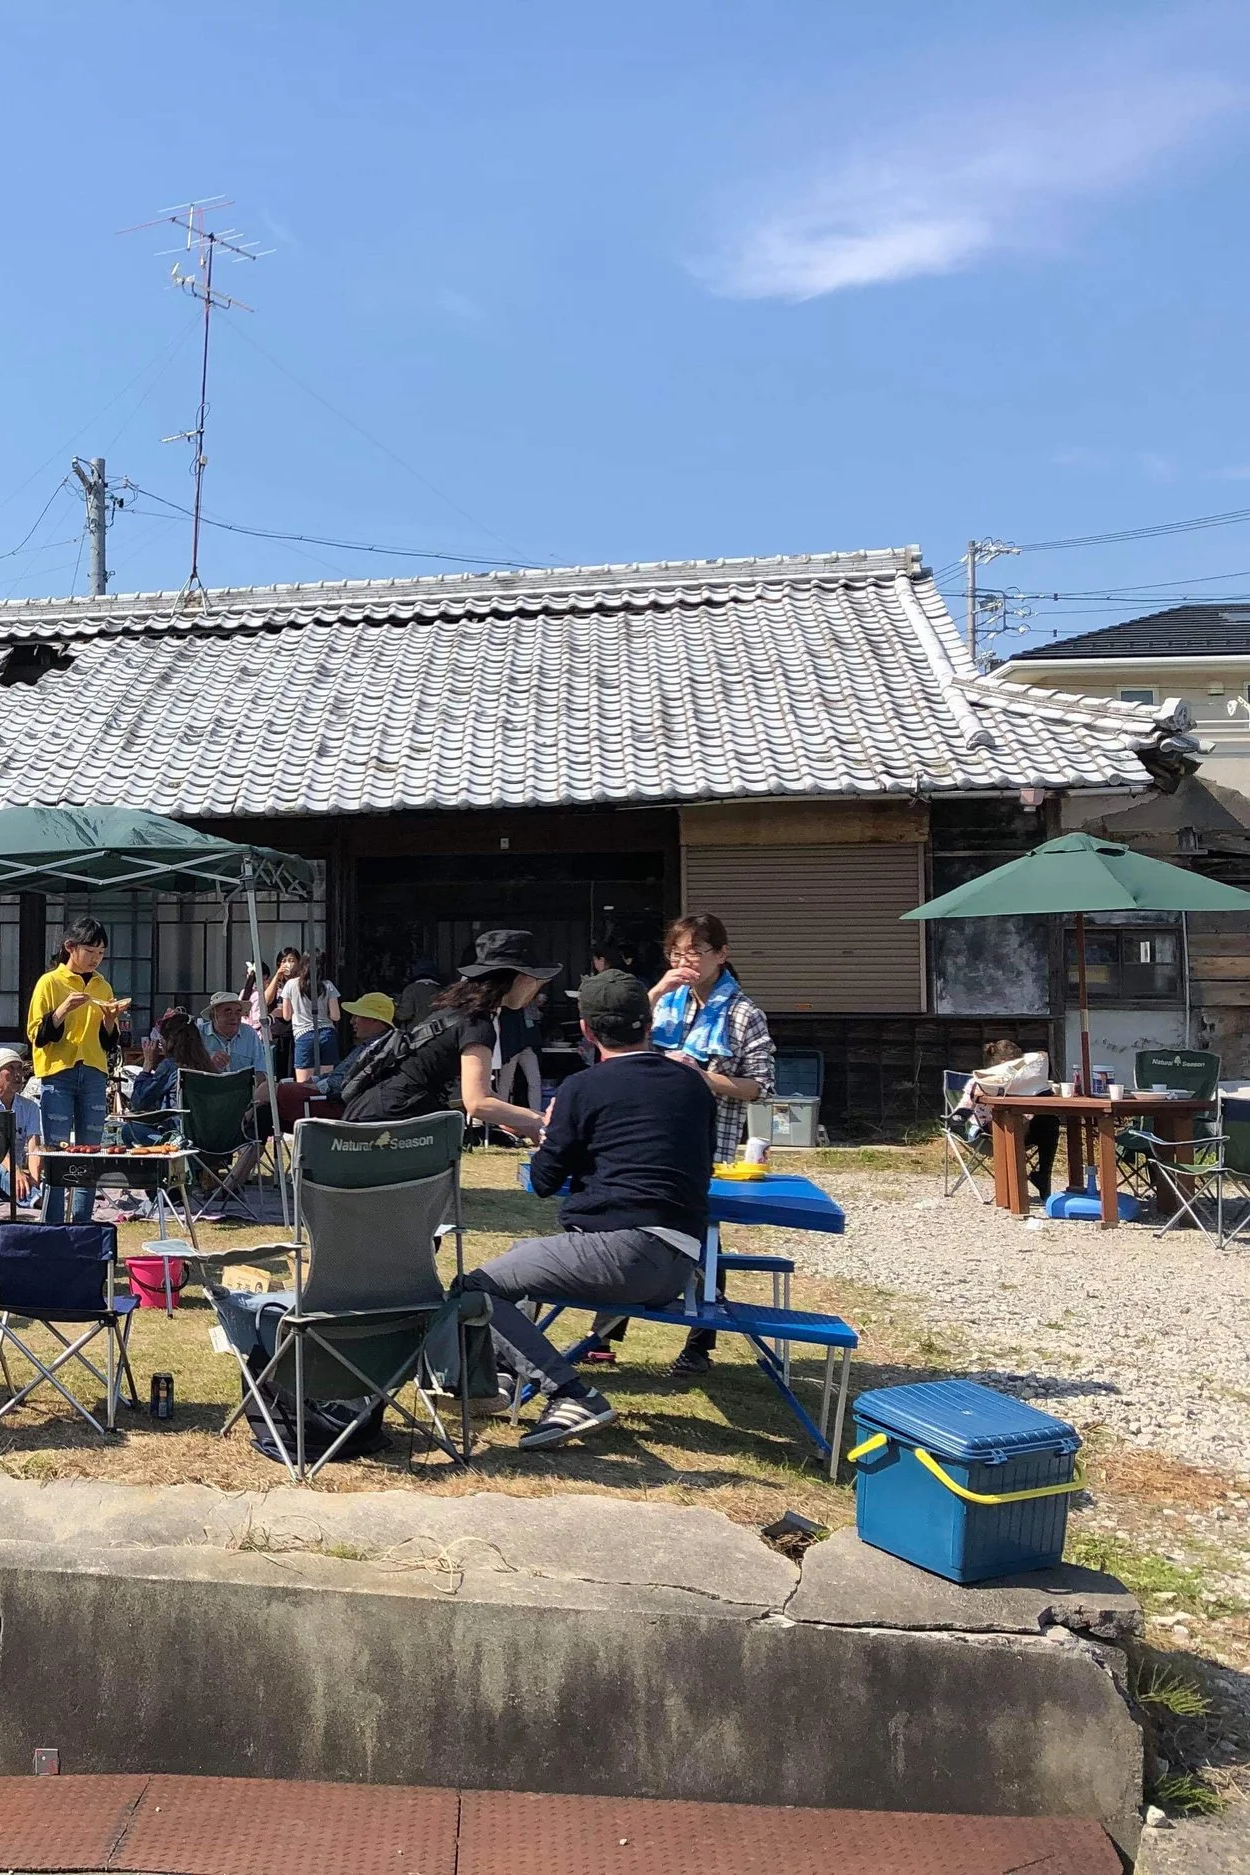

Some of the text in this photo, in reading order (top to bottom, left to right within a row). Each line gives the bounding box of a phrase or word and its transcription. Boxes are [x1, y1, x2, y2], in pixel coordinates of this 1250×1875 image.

[1152, 1058, 1173, 1066] Natural
[331, 1135, 433, 1151] Natural Season
